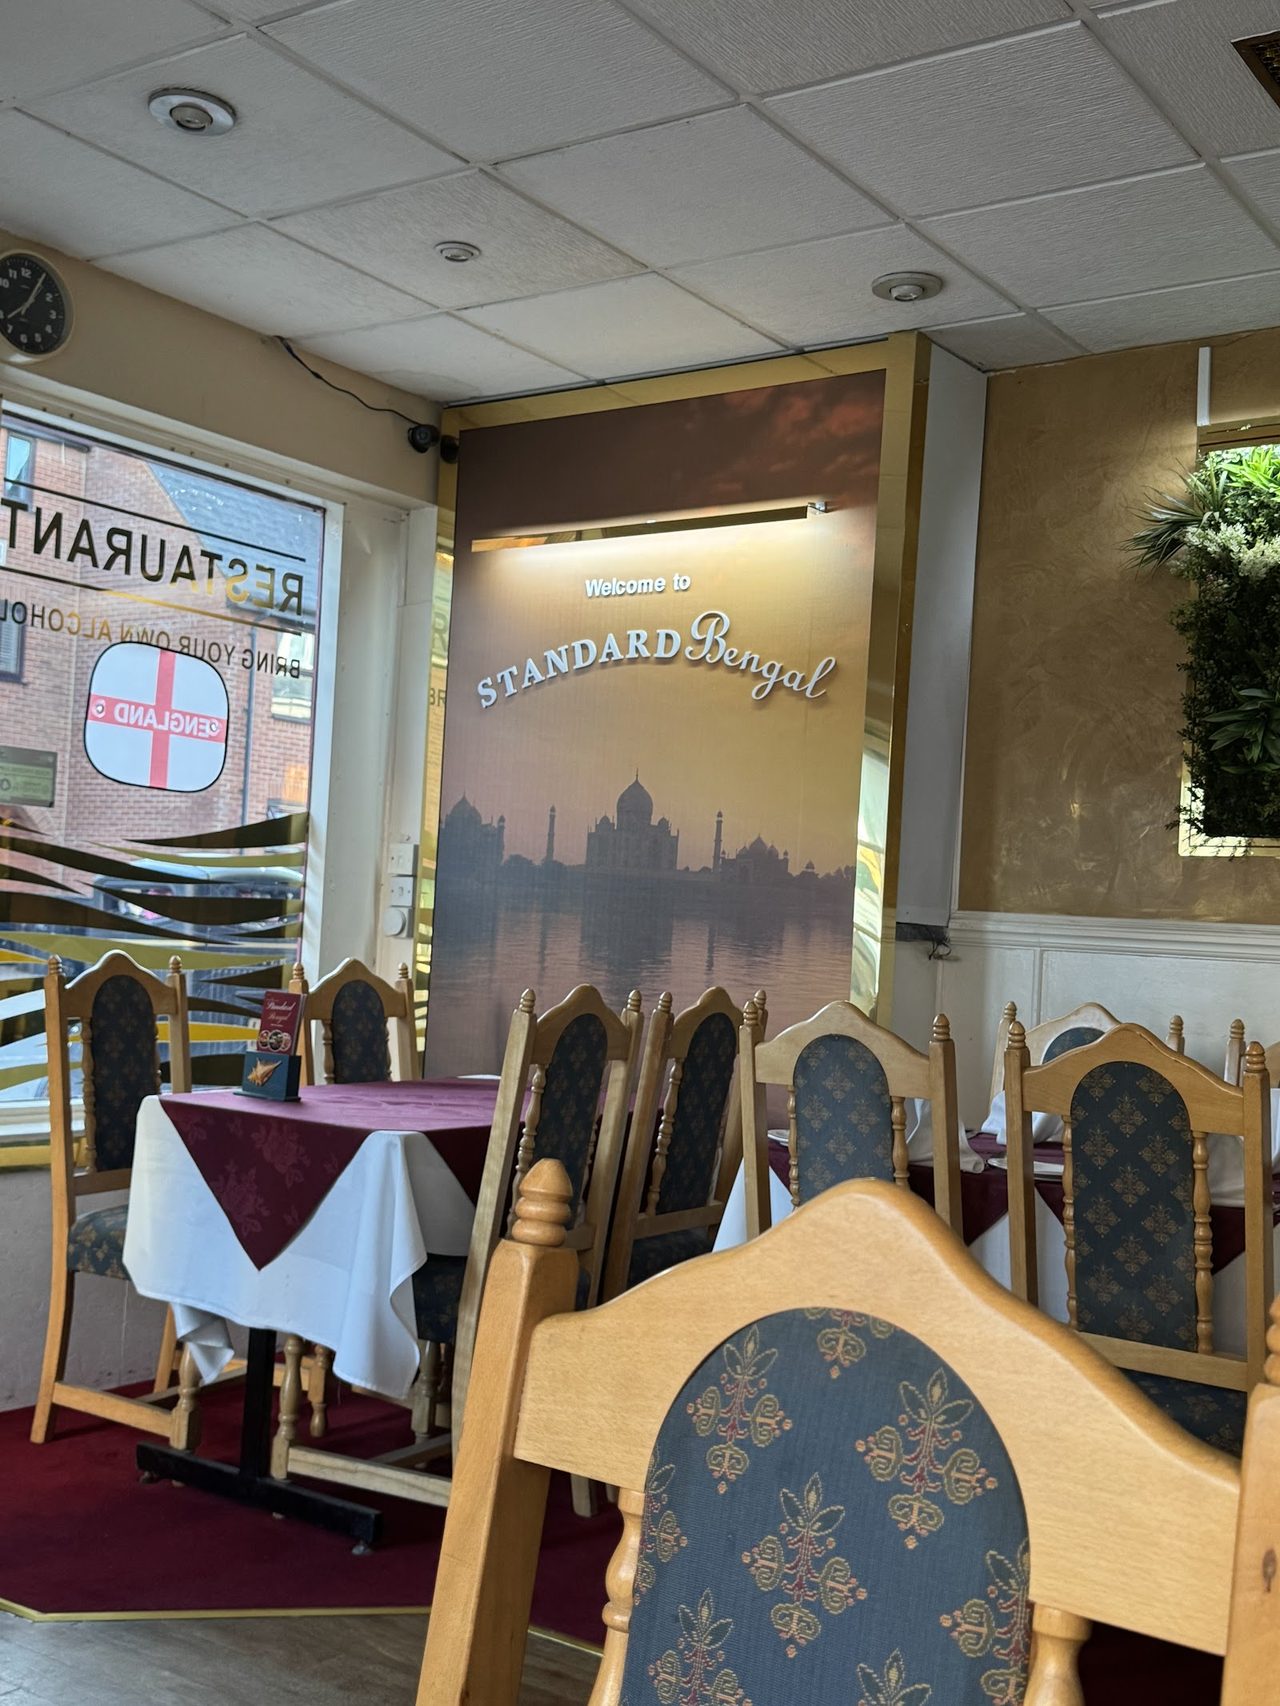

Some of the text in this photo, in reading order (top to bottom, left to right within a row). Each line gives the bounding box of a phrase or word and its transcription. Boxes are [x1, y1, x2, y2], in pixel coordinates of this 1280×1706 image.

[585, 573, 691, 598] Welcome to
[477, 610, 836, 709] STANDARD Bengal
